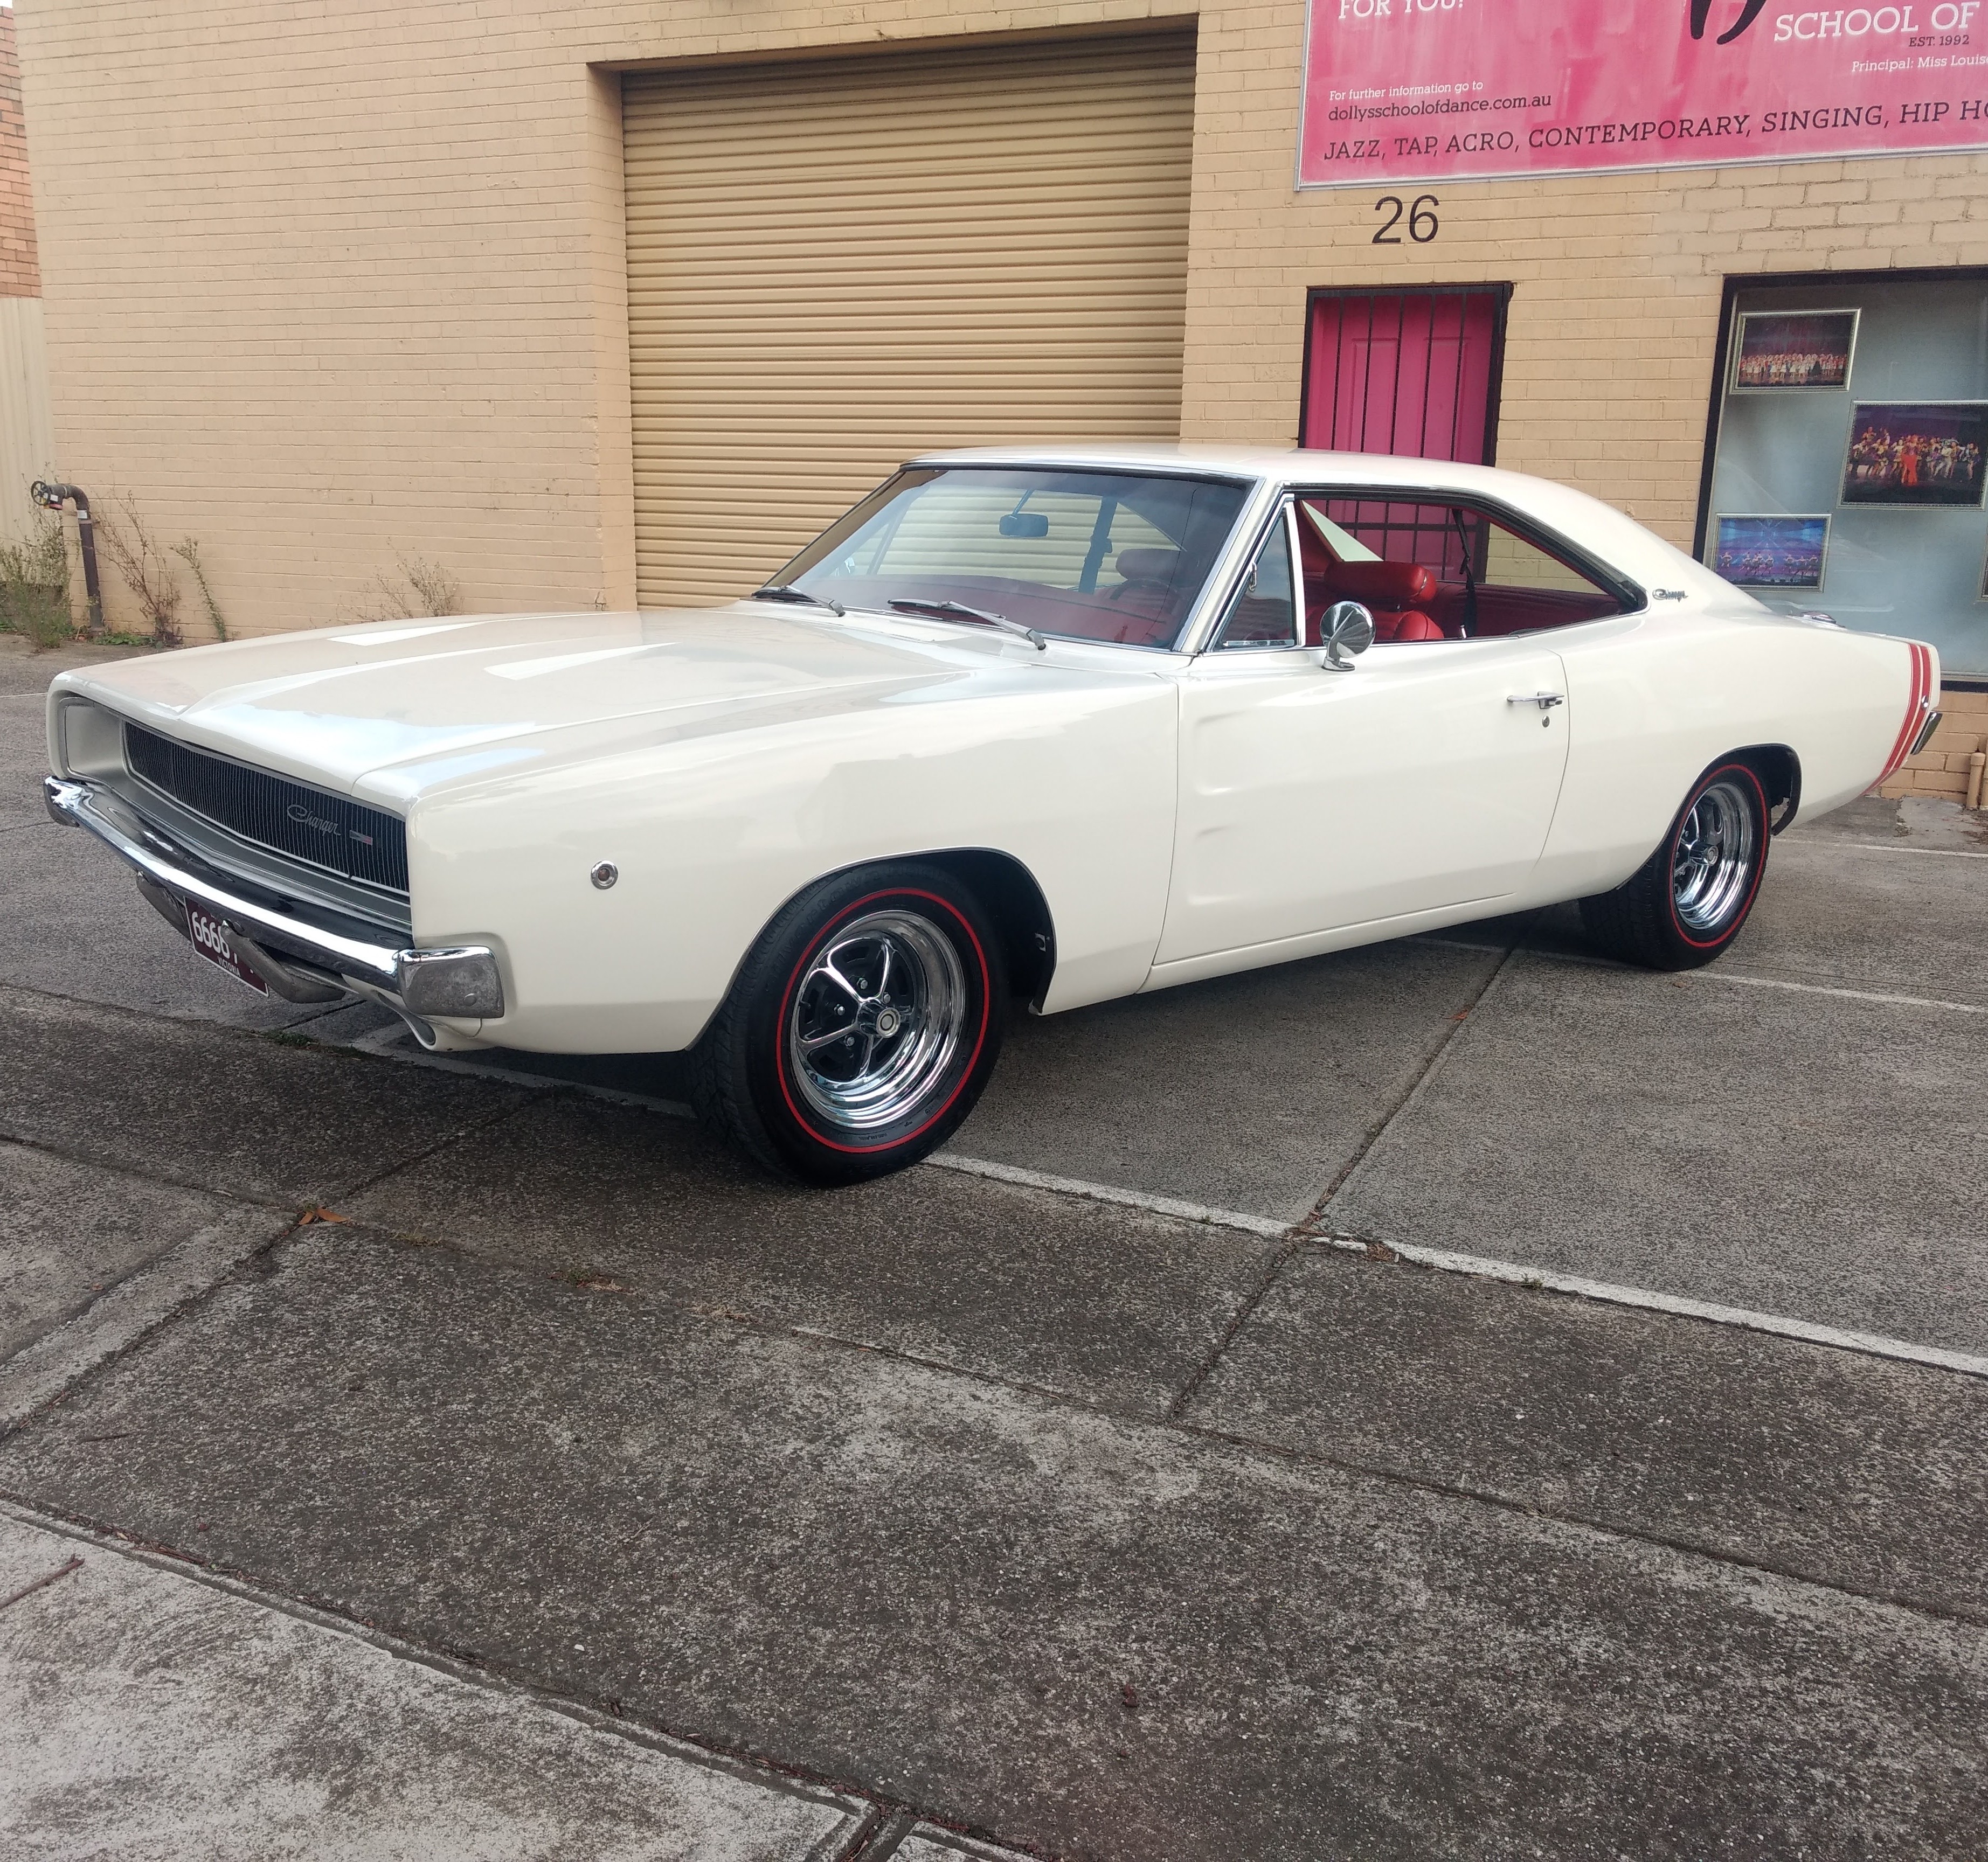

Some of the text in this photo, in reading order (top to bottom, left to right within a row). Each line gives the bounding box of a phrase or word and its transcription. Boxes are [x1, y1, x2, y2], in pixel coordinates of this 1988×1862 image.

[1339, 0, 1391, 19] FOR
[1774, 5, 1919, 41] SCHOOL
[1931, 2, 1980, 29] OF
[1908, 34, 1970, 47] EST. 1992
[1852, 58, 1913, 72] Principal:
[1917, 57, 1947, 68] Miss
[1329, 81, 1484, 101] For further information go to
[1328, 95, 1551, 121] dollysschoolofdance.com.au
[1324, 100, 1988, 160] JAZZ, TAP, ACRO, CONTEMPORARY, SINGING, HIP H
[1371, 194, 1439, 244] 26
[287, 804, 341, 836] Charger
[217, 955, 241, 977] VICTORIA
